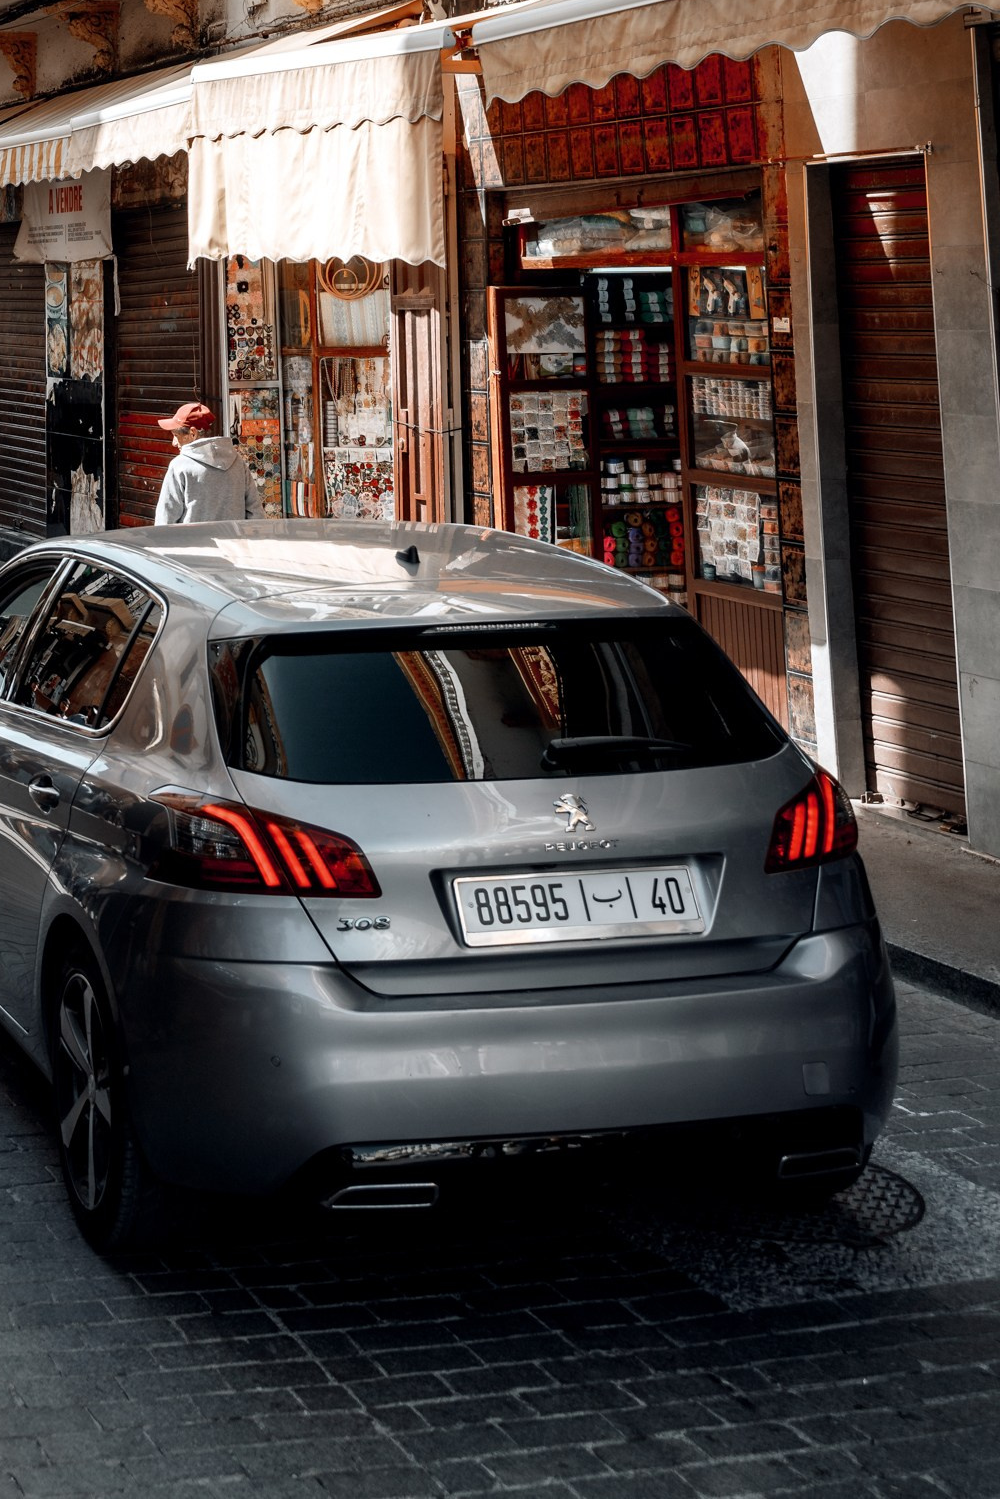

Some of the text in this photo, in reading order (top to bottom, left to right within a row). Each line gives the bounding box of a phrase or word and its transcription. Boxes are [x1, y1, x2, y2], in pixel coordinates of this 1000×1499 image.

[48, 185, 83, 214] A VENDRE
[543, 838, 620, 852] PEUGEOT
[473, 882, 570, 926] 88595
[650, 876, 685, 915] 40
[336, 915, 391, 931] 308
